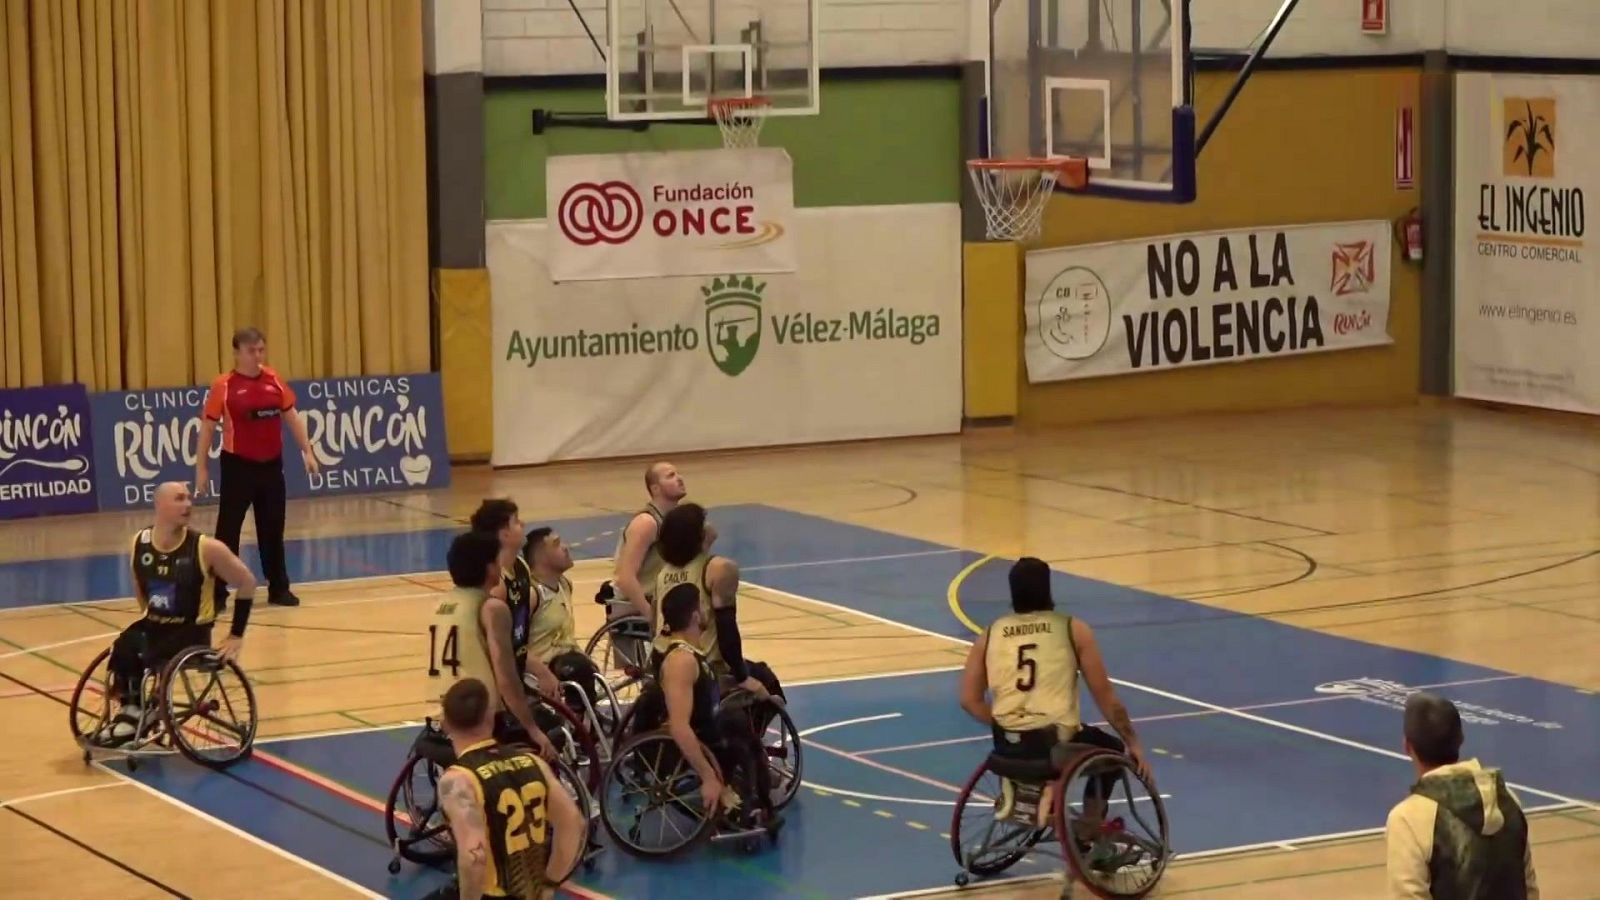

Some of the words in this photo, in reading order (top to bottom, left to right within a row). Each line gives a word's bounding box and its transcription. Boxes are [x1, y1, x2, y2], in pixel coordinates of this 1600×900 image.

[653, 182, 753, 202] Fundación
[1478, 184, 1500, 231] EL
[1506, 185, 1584, 238] INGENIO
[653, 205, 755, 237] ONCE
[1148, 240, 1200, 299] NO
[1213, 236, 1238, 292] A
[1249, 233, 1294, 288] LA
[1478, 242, 1517, 258] CENTRO
[1521, 245, 1581, 263] COMERCIAL
[506, 322, 699, 368] Ayuntamiento
[771, 307, 940, 345] Vélez-Málaga
[1123, 296, 1324, 368] VIOLENCIA
[125, 389, 210, 410] CLINIC
[308, 377, 410, 399] CLINICAS
[0, 405, 81, 459] INCÓN
[0, 479, 91, 501] ERTILIDAD
[308, 466, 403, 490] DENTAL
[1003, 622, 1053, 638] SANDOVAL
[428, 625, 461, 676] 14
[1016, 643, 1037, 692] 5
[497, 780, 547, 855] 23
